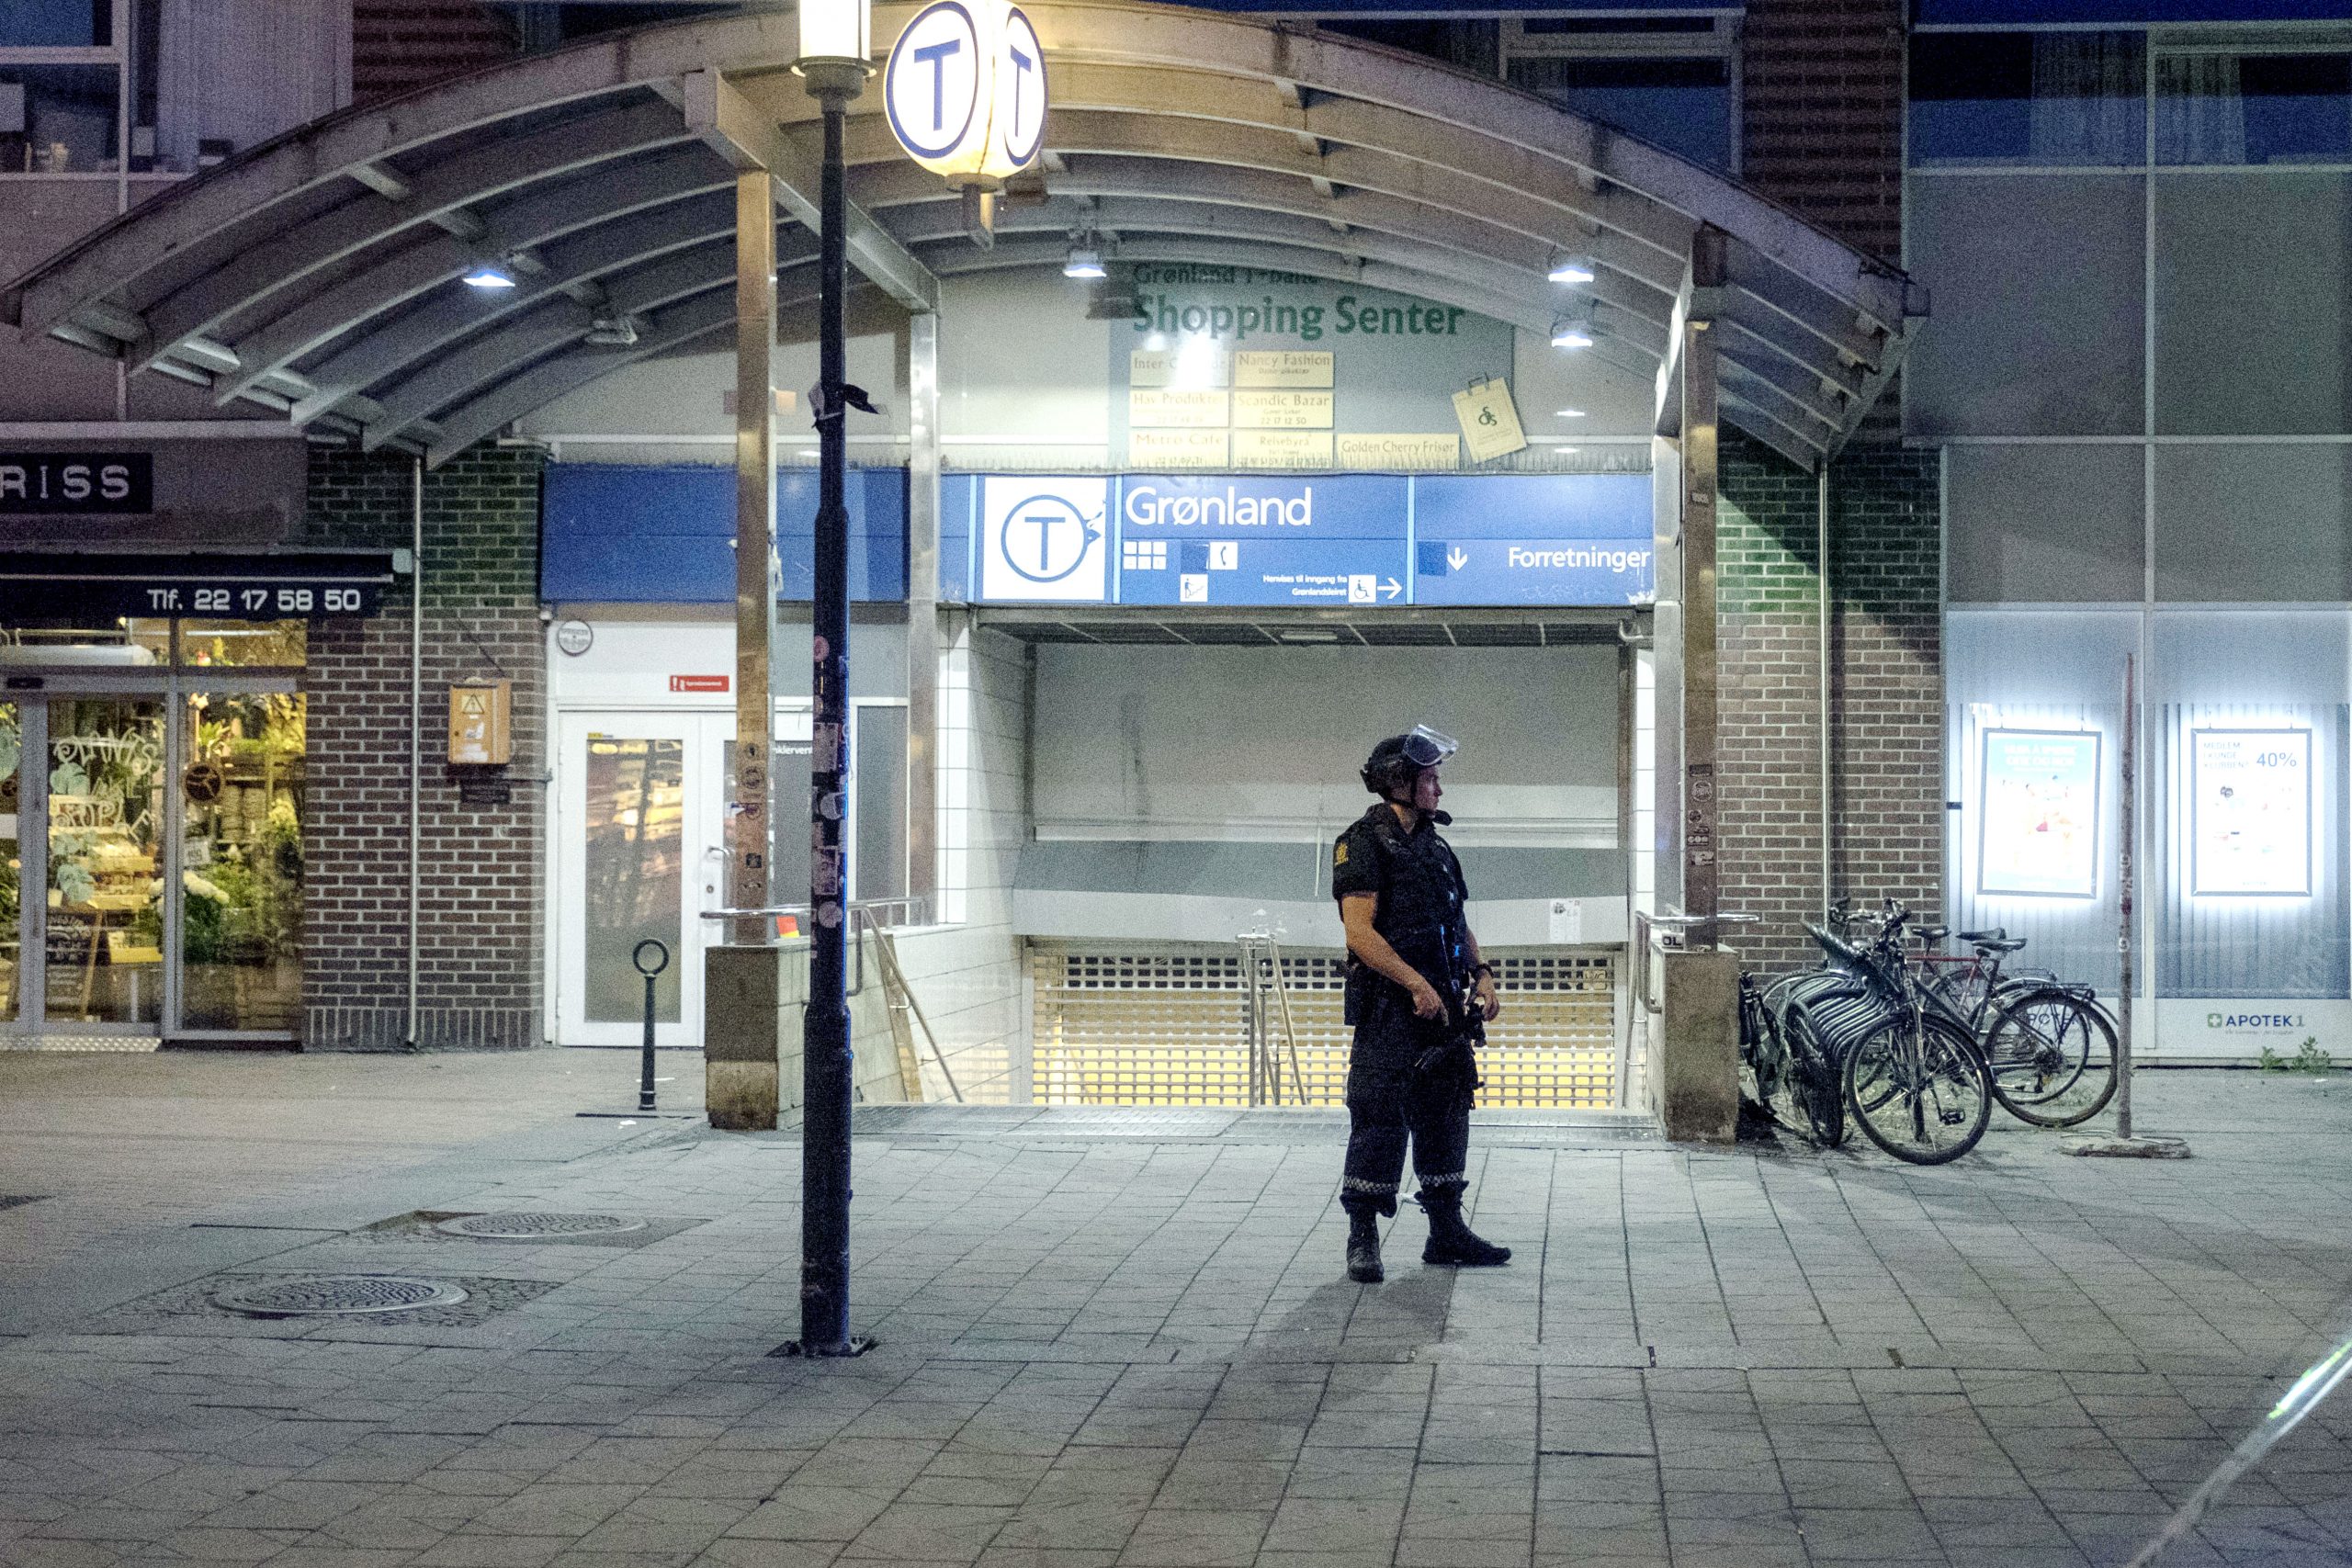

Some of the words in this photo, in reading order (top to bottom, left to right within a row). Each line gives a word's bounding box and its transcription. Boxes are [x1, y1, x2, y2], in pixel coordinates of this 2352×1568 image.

[914, 39, 960, 131] T
[1010, 44, 1032, 138] T
[1133, 295, 1325, 341] Shopping
[1335, 296, 1465, 336] Senter
[1238, 354, 1278, 367] Nancy
[1284, 353, 1330, 366] Fashion
[1238, 394, 1287, 406] Scandic
[1294, 394, 1329, 406] Bazar
[1295, 417, 1307, 425] 50
[1341, 440, 1379, 453] Golden
[1383, 440, 1420, 455] Cherry
[1125, 486, 1312, 526] Grønland
[1023, 515, 1067, 570] T
[1509, 546, 1651, 573] Forretninger
[1295, 574, 1304, 583] til
[1305, 574, 1335, 585] inngang
[1337, 574, 1348, 583] fra
[147, 589, 184, 611] Tlf.
[194, 589, 231, 611] 22
[241, 589, 269, 611] 17
[277, 589, 313, 611] 58
[324, 589, 361, 611] 50
[2256, 752, 2297, 768] 40%
[2225, 1015, 2293, 1027] APOTEK
[2296, 1015, 2304, 1027] 1
